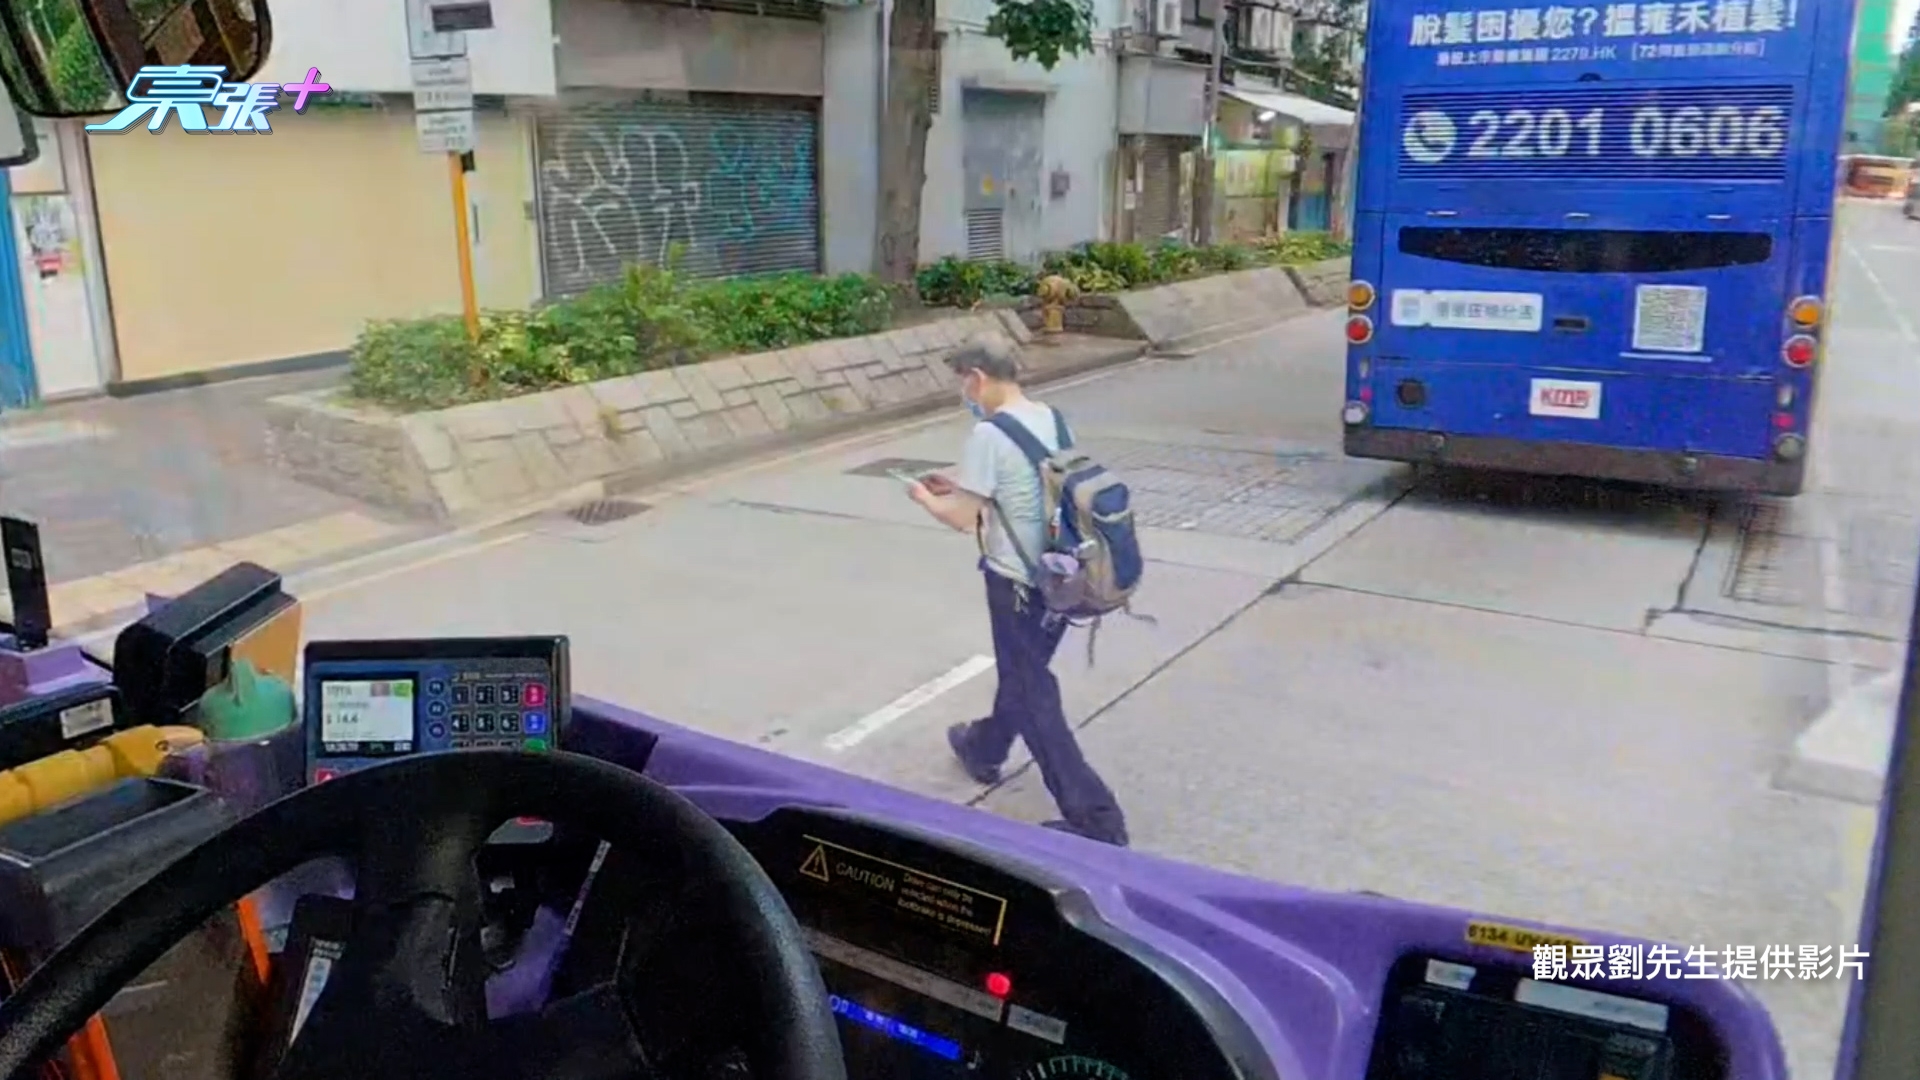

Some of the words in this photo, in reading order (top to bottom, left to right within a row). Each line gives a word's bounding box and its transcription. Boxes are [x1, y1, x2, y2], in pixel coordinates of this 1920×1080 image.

[1466, 107, 1605, 157] 2201
[1629, 105, 1786, 156] 0606
[836, 862, 895, 893] CAUTION
